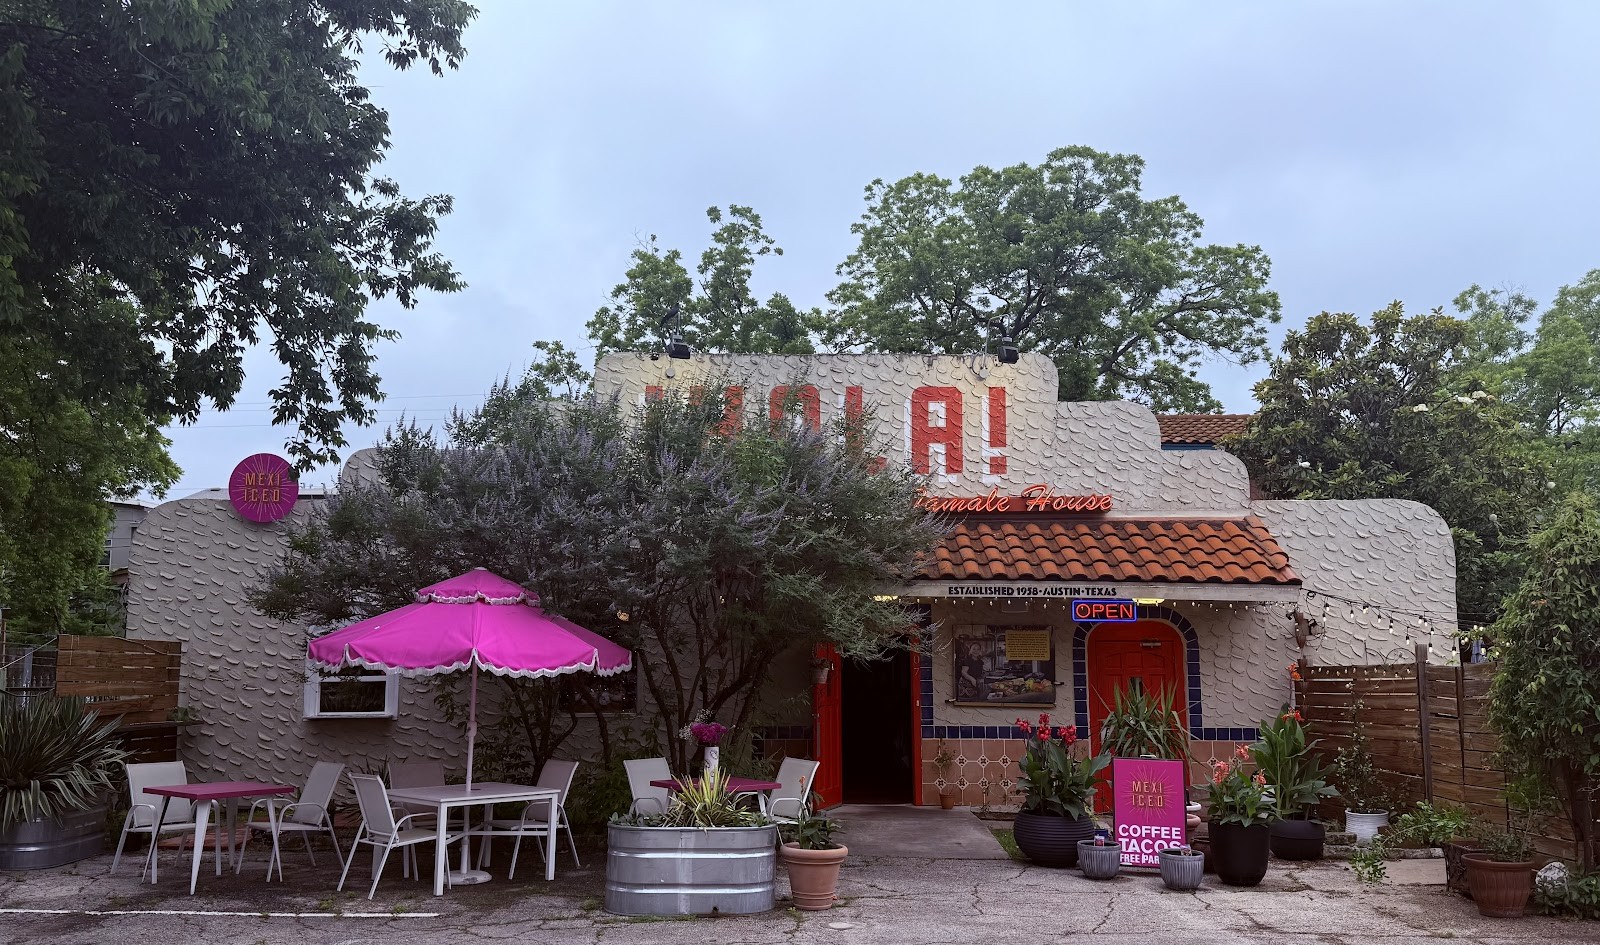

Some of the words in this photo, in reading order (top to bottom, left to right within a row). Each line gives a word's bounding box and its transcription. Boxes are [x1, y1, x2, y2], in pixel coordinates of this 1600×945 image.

[245, 472, 280, 486] MEXI
[244, 488, 280, 502] ICED
[1021, 484, 1114, 512] House
[949, 586, 1014, 596] ESTABLISHED
[1075, 603, 1133, 619] OPEN
[1132, 780, 1162, 793] MEXI
[1132, 795, 1163, 807] ICED
[1118, 824, 1182, 840] COFFEE
[1120, 853, 1140, 864] FREE
[1141, 853, 1160, 865] PAR
